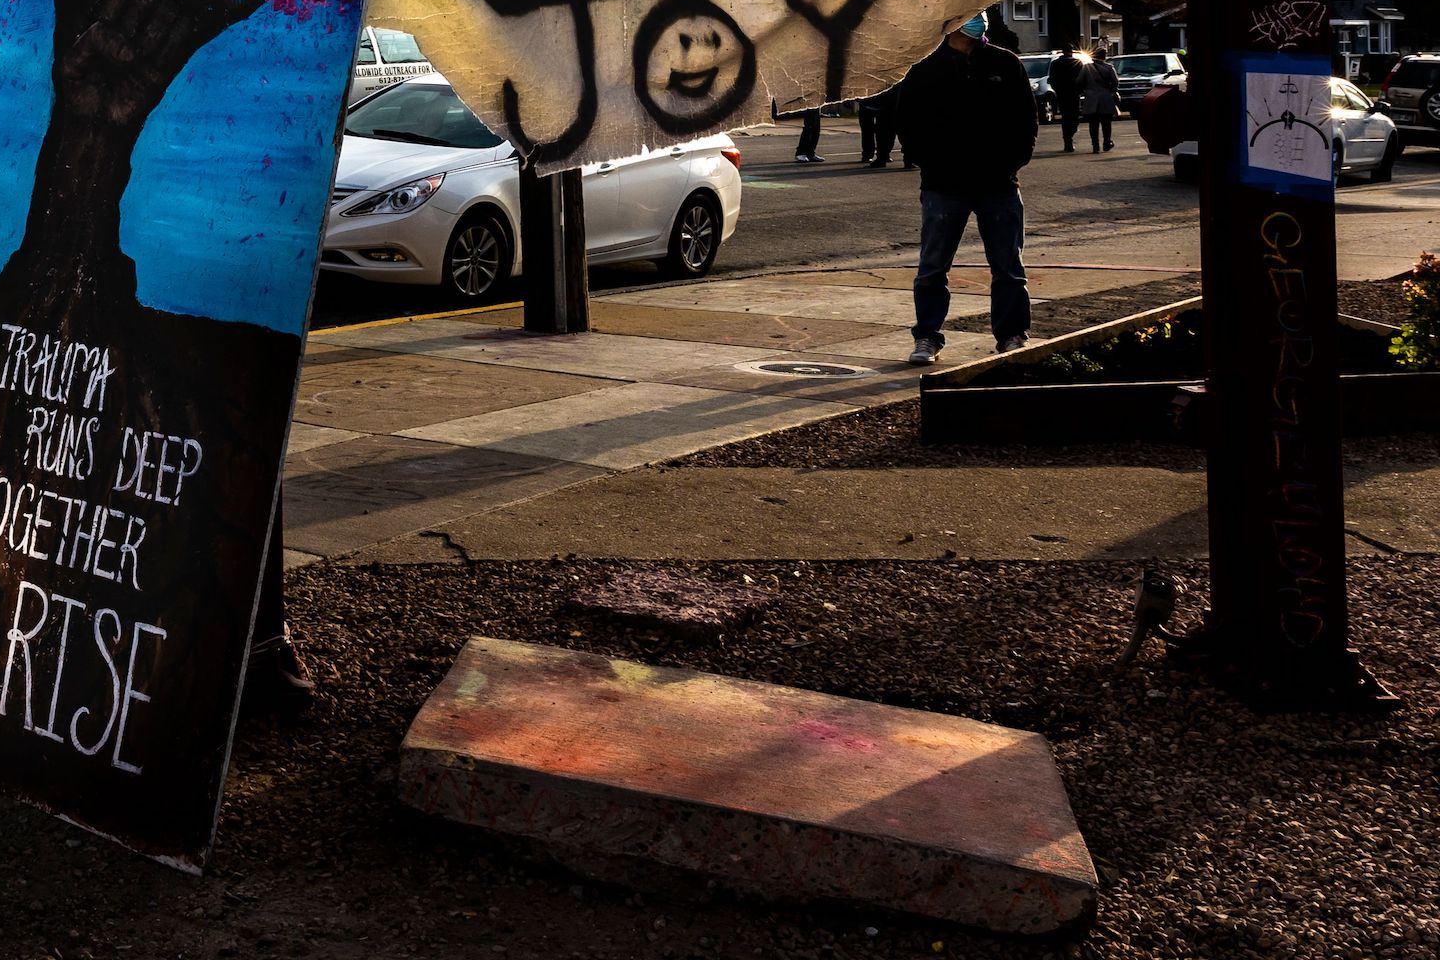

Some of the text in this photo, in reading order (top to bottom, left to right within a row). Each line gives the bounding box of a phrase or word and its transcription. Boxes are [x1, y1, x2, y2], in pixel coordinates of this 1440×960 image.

[384, 65, 417, 76] OUTREACH
[418, 65, 430, 74] FOR
[0, 322, 117, 413] TRAUMA
[23, 405, 204, 507] RUNS DEEP
